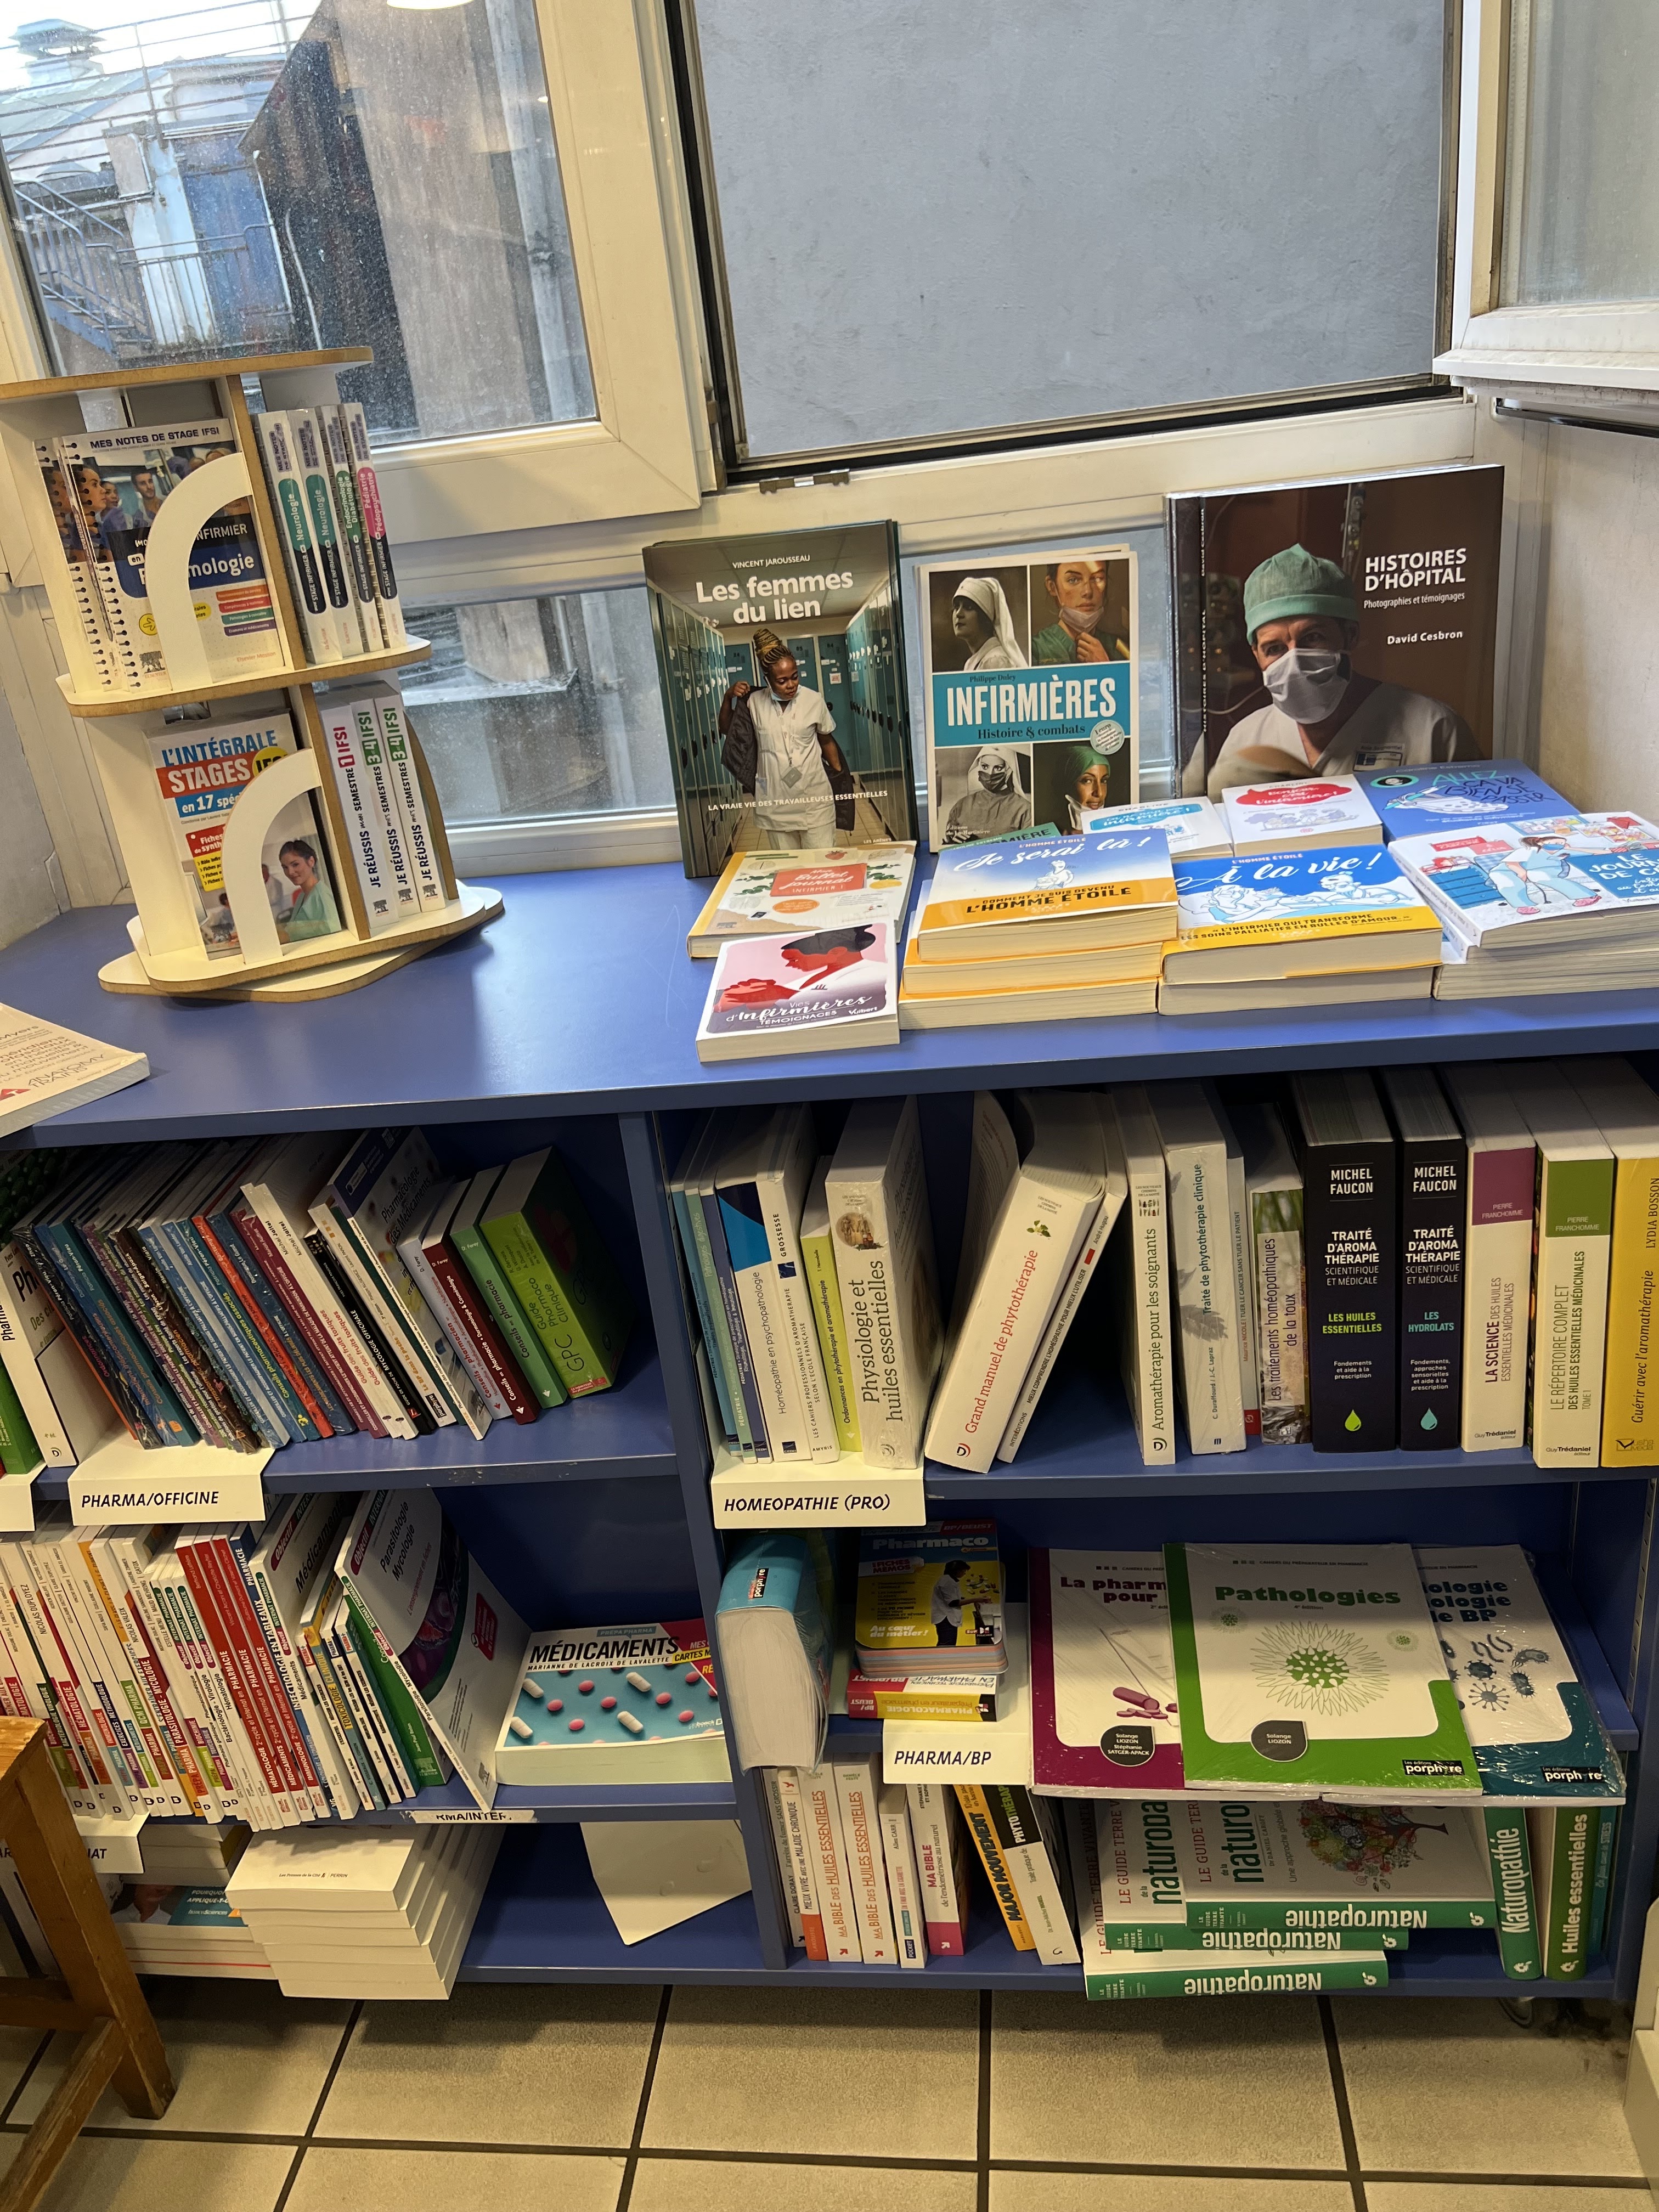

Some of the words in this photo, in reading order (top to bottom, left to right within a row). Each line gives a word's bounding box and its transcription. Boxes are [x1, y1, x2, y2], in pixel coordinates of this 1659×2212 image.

[91, 440, 112, 449] MES
[116, 436, 148, 446] NOTES
[153, 433, 165, 442] DE
[168, 430, 198, 440] STAGE
[338, 477, 353, 529] Endocrinologie
[344, 476, 358, 522] Diabétologie
[360, 473, 371, 509] Pédiatrie
[368, 472, 383, 532] Pédopsychiatrie
[288, 494, 304, 541] Neurologie
[315, 490, 329, 536] Neurologie
[732, 560, 764, 569] VINCENT
[765, 555, 810, 567] JAROUSSEAU
[1365, 548, 1466, 573] HISTOIRES
[696, 582, 739, 603] Les
[747, 571, 854, 597] femmes
[1364, 568, 1465, 591] D'HÔPITAL
[733, 604, 765, 624] du
[774, 599, 821, 620] lien
[1363, 597, 1412, 608] Photographies
[1421, 591, 1465, 605] témoignages
[1387, 634, 1417, 645] David
[1420, 630, 1463, 642] Cesbron
[969, 675, 996, 684] Philippe
[947, 674, 1116, 726] INFIRMIÈRES
[358, 712, 374, 737] IFSI
[383, 708, 399, 733] IFSI
[978, 728, 1023, 740] Histoire
[1038, 724, 1085, 737] combats
[162, 730, 278, 767] L'INTÉGRALE
[333, 726, 350, 753] IFSI
[168, 758, 251, 793] STAGES
[346, 768, 362, 811] SEMESTRE
[374, 766, 390, 812] SEMESTRES
[398, 762, 414, 808] SEMESTRES
[182, 803, 195, 813] en
[196, 794, 213, 811] 17
[720, 802, 742, 810] VRAIE
[774, 794, 833, 806] TRAVAILLEUSES
[835, 791, 887, 800] ESSENTIELLES
[361, 831, 379, 874] RÉUSSIS
[953, 852, 1003, 872] Je
[1011, 844, 1085, 865] serai
[1097, 838, 1132, 850] là
[1253, 864, 1299, 879] la
[1308, 856, 1363, 873] vie
[967, 896, 1054, 913] L'HOMME
[1305, 913, 1372, 924] TRANSFORME
[760, 1011, 837, 1025] TÉMOIGNAGES
[849, 1007, 877, 1015] Vuibert
[1331, 1169, 1373, 1181] MICHEL
[1413, 1180, 1457, 1192] FAUCON
[1414, 1166, 1456, 1178] MICHEL
[381, 1166, 420, 1223] Pharmacologie
[1330, 1182, 1373, 1194] FAUCON
[399, 1178, 431, 1230] Médicaments
[1482, 1210, 1523, 1219] FRANCHOMME
[276, 1237, 288, 1256] Michel
[772, 1214, 787, 1257] GROSSESSE
[1328, 1242, 1376, 1253] D'AROMA
[1332, 1228, 1372, 1240] TRAITÉ
[1646, 1219, 1657, 1249] LYDIA
[1147, 1228, 1160, 1290] soignants
[1325, 1252, 1379, 1265] THÉRAPIE
[1325, 1266, 1379, 1275] SCIENTIFIQUE
[1339, 1276, 1378, 1285] MÉDICALE
[485, 1279, 513, 1321] pharmacie
[528, 1277, 558, 1327] Pharmaco
[544, 1284, 569, 1323] Clinique
[752, 1272, 775, 1341] psychopathologie
[866, 1261, 896, 1363] essentielles
[1554, 1285, 1569, 1333] COMPLET
[320, 1310, 340, 1334] toxiques
[334, 1311, 354, 1336] toxiques
[529, 1302, 547, 1330] Guide
[1152, 1311, 1163, 1340] pour
[1322, 1324, 1382, 1334] ESSENTIELLES
[1329, 1313, 1344, 1322] LES
[1346, 1312, 1376, 1321] HUILES
[1408, 1323, 1454, 1333] HYDROLATS
[509, 1327, 530, 1358] Conseils
[554, 1334, 584, 1371] GPC
[852, 1300, 880, 1404] Physiologie
[965, 1397, 987, 1433] Grand
[980, 1352, 1003, 1397] manuel
[1000, 1250, 1038, 1336] phytothérapie
[1486, 1321, 1499, 1368] SCIENCE
[771, 1358, 787, 1414] Homéopathie
[874, 1368, 903, 1423] huiles
[1148, 1342, 1164, 1431] Aromathérapie
[838, 1382, 850, 1424] Ordonnances
[1631, 1391, 1646, 1424] Guérir
[81, 1492, 218, 1507] PHARMA/OFFICINE
[724, 1497, 839, 1511] HOMEOPATHIE
[844, 1494, 891, 1511] (PRO)
[353, 1529, 370, 1566] Objectif
[380, 1502, 409, 1573] Parasitologie
[392, 1524, 415, 1582] Mycologie
[873, 1537, 989, 1549] Pharmaco
[1060, 1577, 1085, 1588] La
[1103, 1592, 1158, 1603] pour
[1215, 1585, 1401, 1606] Pathologies
[529, 1637, 680, 1663] MÉDICAMENTS
[675, 1651, 702, 1661] CARTES
[220, 1651, 240, 1690] PHARMACIE
[239, 1649, 258, 1688] PHARMACIE
[290, 1661, 307, 1700] Médicaments
[64, 1686, 86, 1728] HÉMATOLOGIE
[215, 1673, 232, 1710] Hématologie
[329, 1685, 352, 1728] TOXICOLOGIE
[161, 1698, 183, 1743] PARASITOLOGIE
[887, 1706, 972, 1714] PHARMACOLOGIE
[894, 1751, 991, 1765] PHARMA/BP
[812, 1790, 833, 1851] ESSENTIELLES
[849, 1791, 870, 1853] ESSENTIELLES
[1110, 1811, 1125, 1846] TERRE
[922, 1845, 934, 1870] BIBLE
[968, 1813, 1005, 1881] MOUVEMENT
[1192, 1827, 1207, 1864] GUIDE
[1568, 1814, 1588, 1904] essentielles
[823, 1854, 838, 1885] HUILES
[859, 1855, 874, 1886] HUILES
[1115, 1850, 1129, 1886] GUIDE
[1199, 1867, 1211, 1883] LE
[1492, 1828, 1530, 1933] Naturopathie
[997, 1881, 1023, 1921] MAJOR
[1120, 1889, 1131, 1904] LE
[832, 1902, 843, 1924] BIBLE
[868, 1904, 879, 1926] BIBLE
[1285, 1904, 1427, 1928] Naturopathie
[1203, 1928, 1340, 1950] Naturopathie
[1562, 1908, 1581, 1953] Huiles
[1184, 1970, 1322, 1996] Naturopathie
